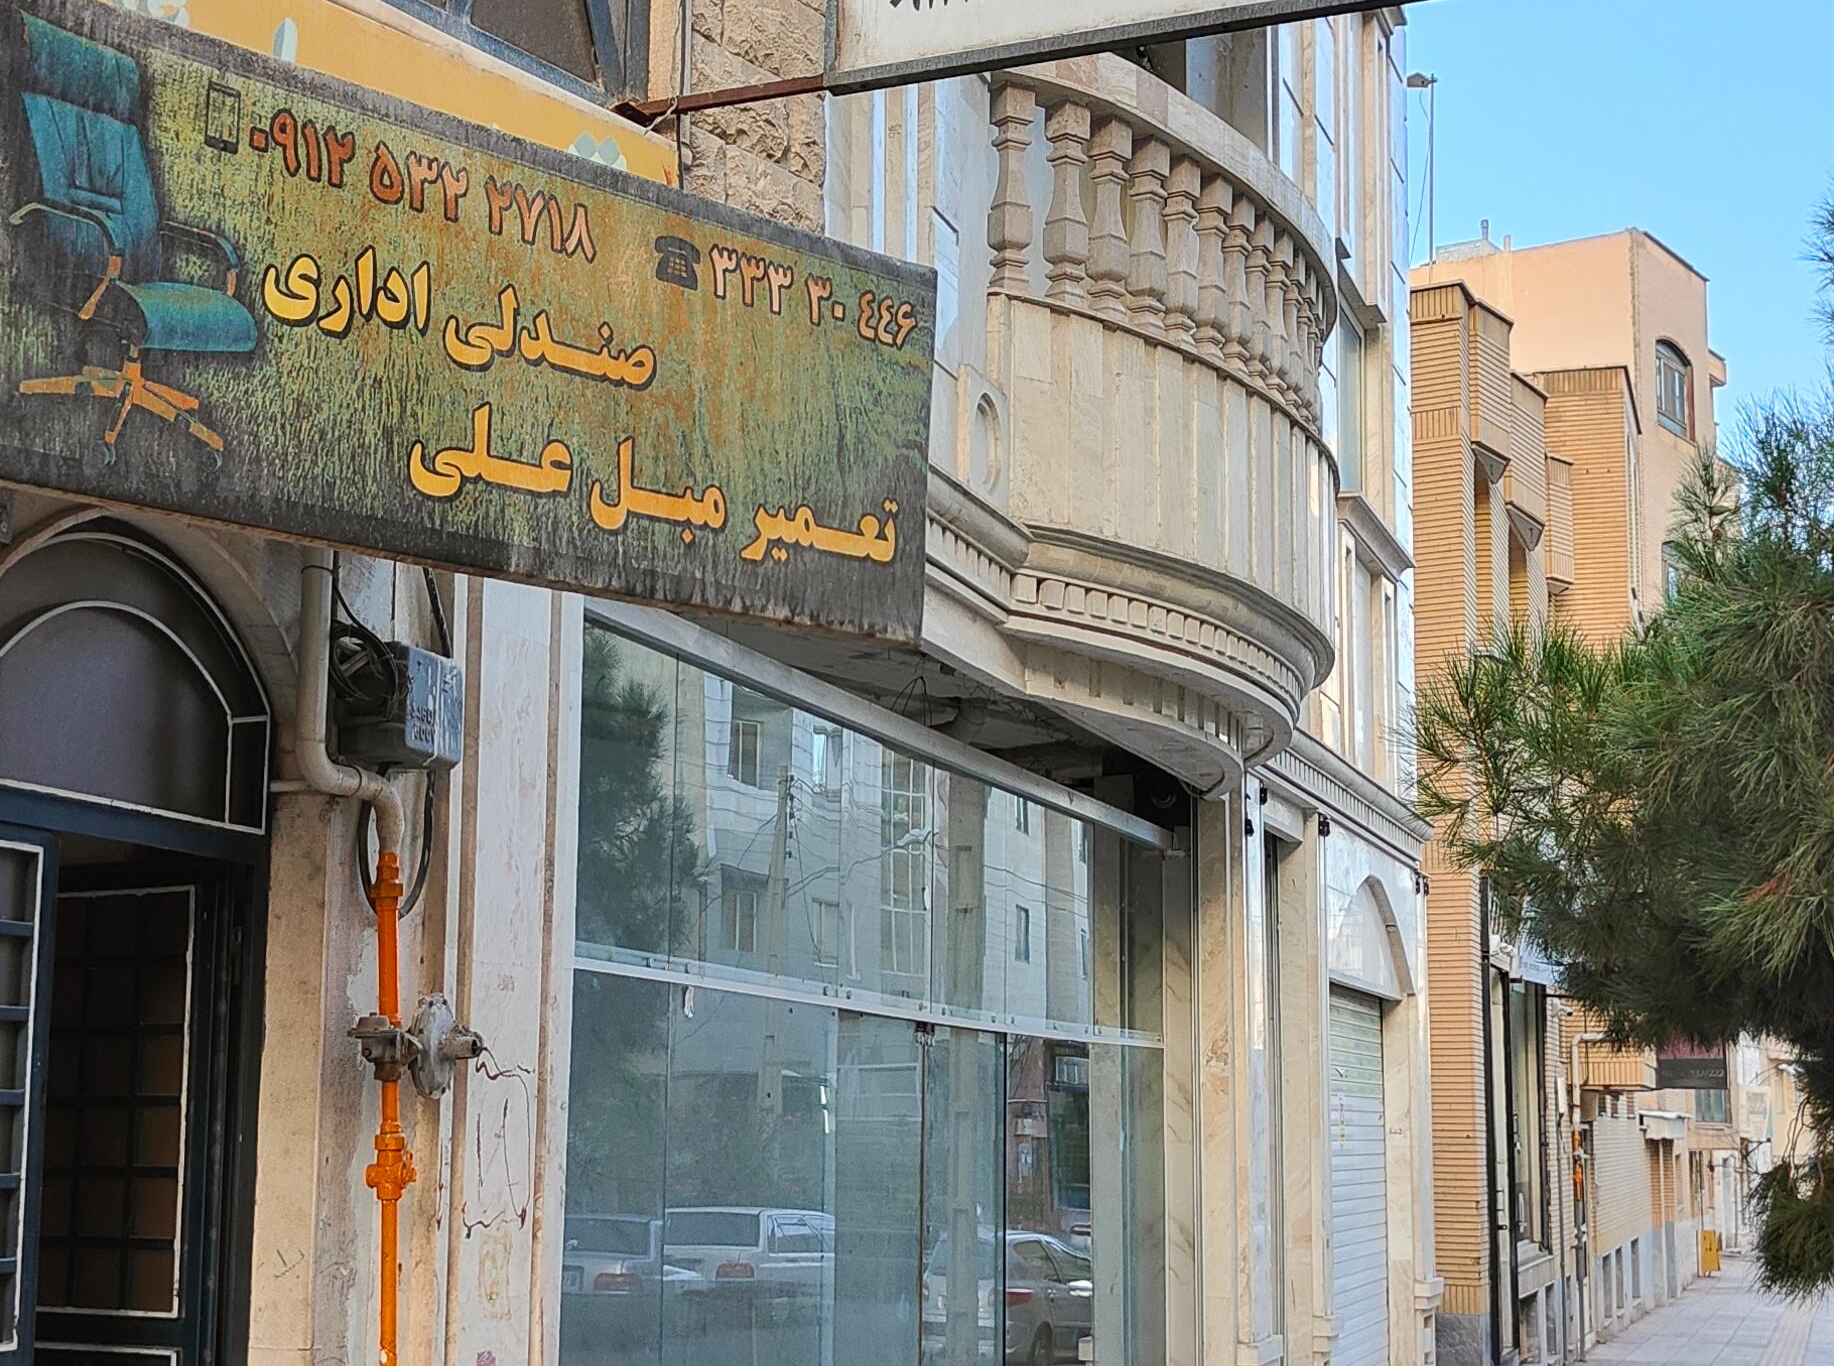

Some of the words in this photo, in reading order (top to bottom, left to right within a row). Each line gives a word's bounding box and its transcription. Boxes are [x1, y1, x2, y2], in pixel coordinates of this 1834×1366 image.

[261, 244, 432, 339] اداری
[443, 282, 657, 392] صندلی
[407, 401, 574, 500] علی
[588, 434, 728, 546] مبل
[740, 497, 899, 565] تعمیر
